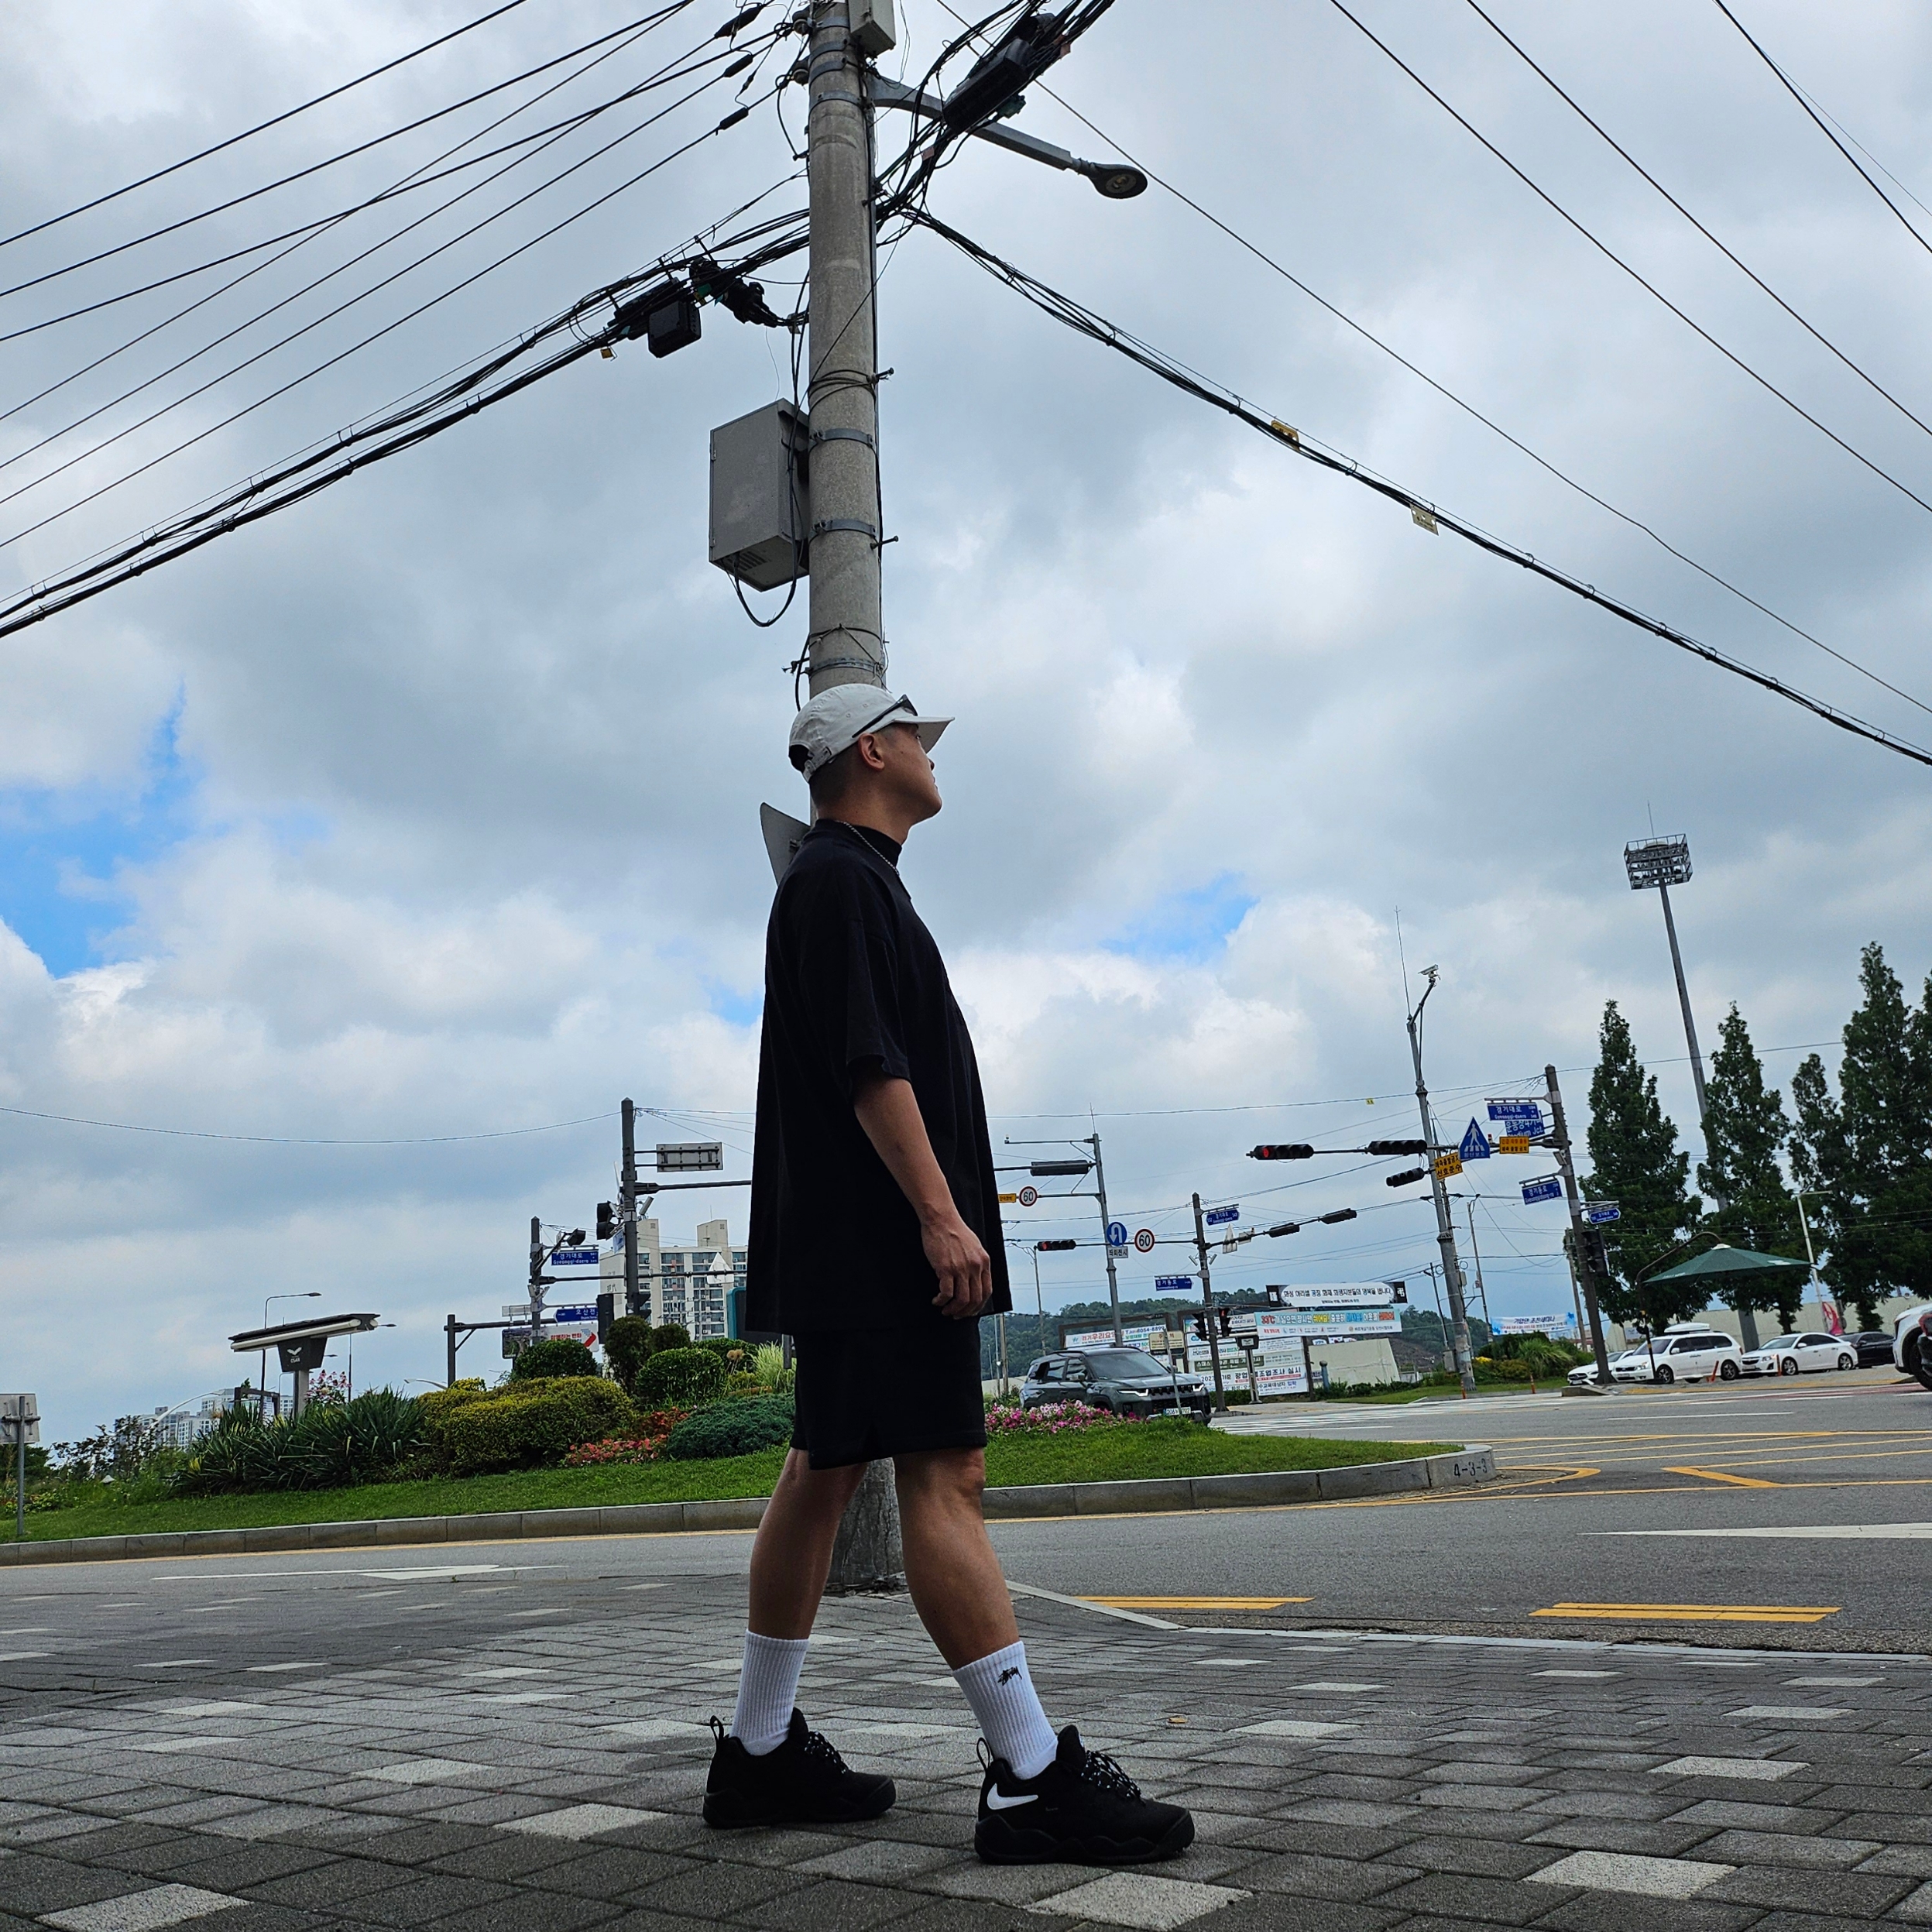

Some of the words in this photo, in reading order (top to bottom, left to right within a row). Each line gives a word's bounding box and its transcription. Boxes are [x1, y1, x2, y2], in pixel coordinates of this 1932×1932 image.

[1495, 1106, 1522, 1114] 경기대로
[1437, 1164, 1461, 1177] 신호준수
[1023, 1191, 1034, 1203] 60
[1138, 1234, 1151, 1247] 60
[1453, 1458, 1488, 1477] 4-3-3
